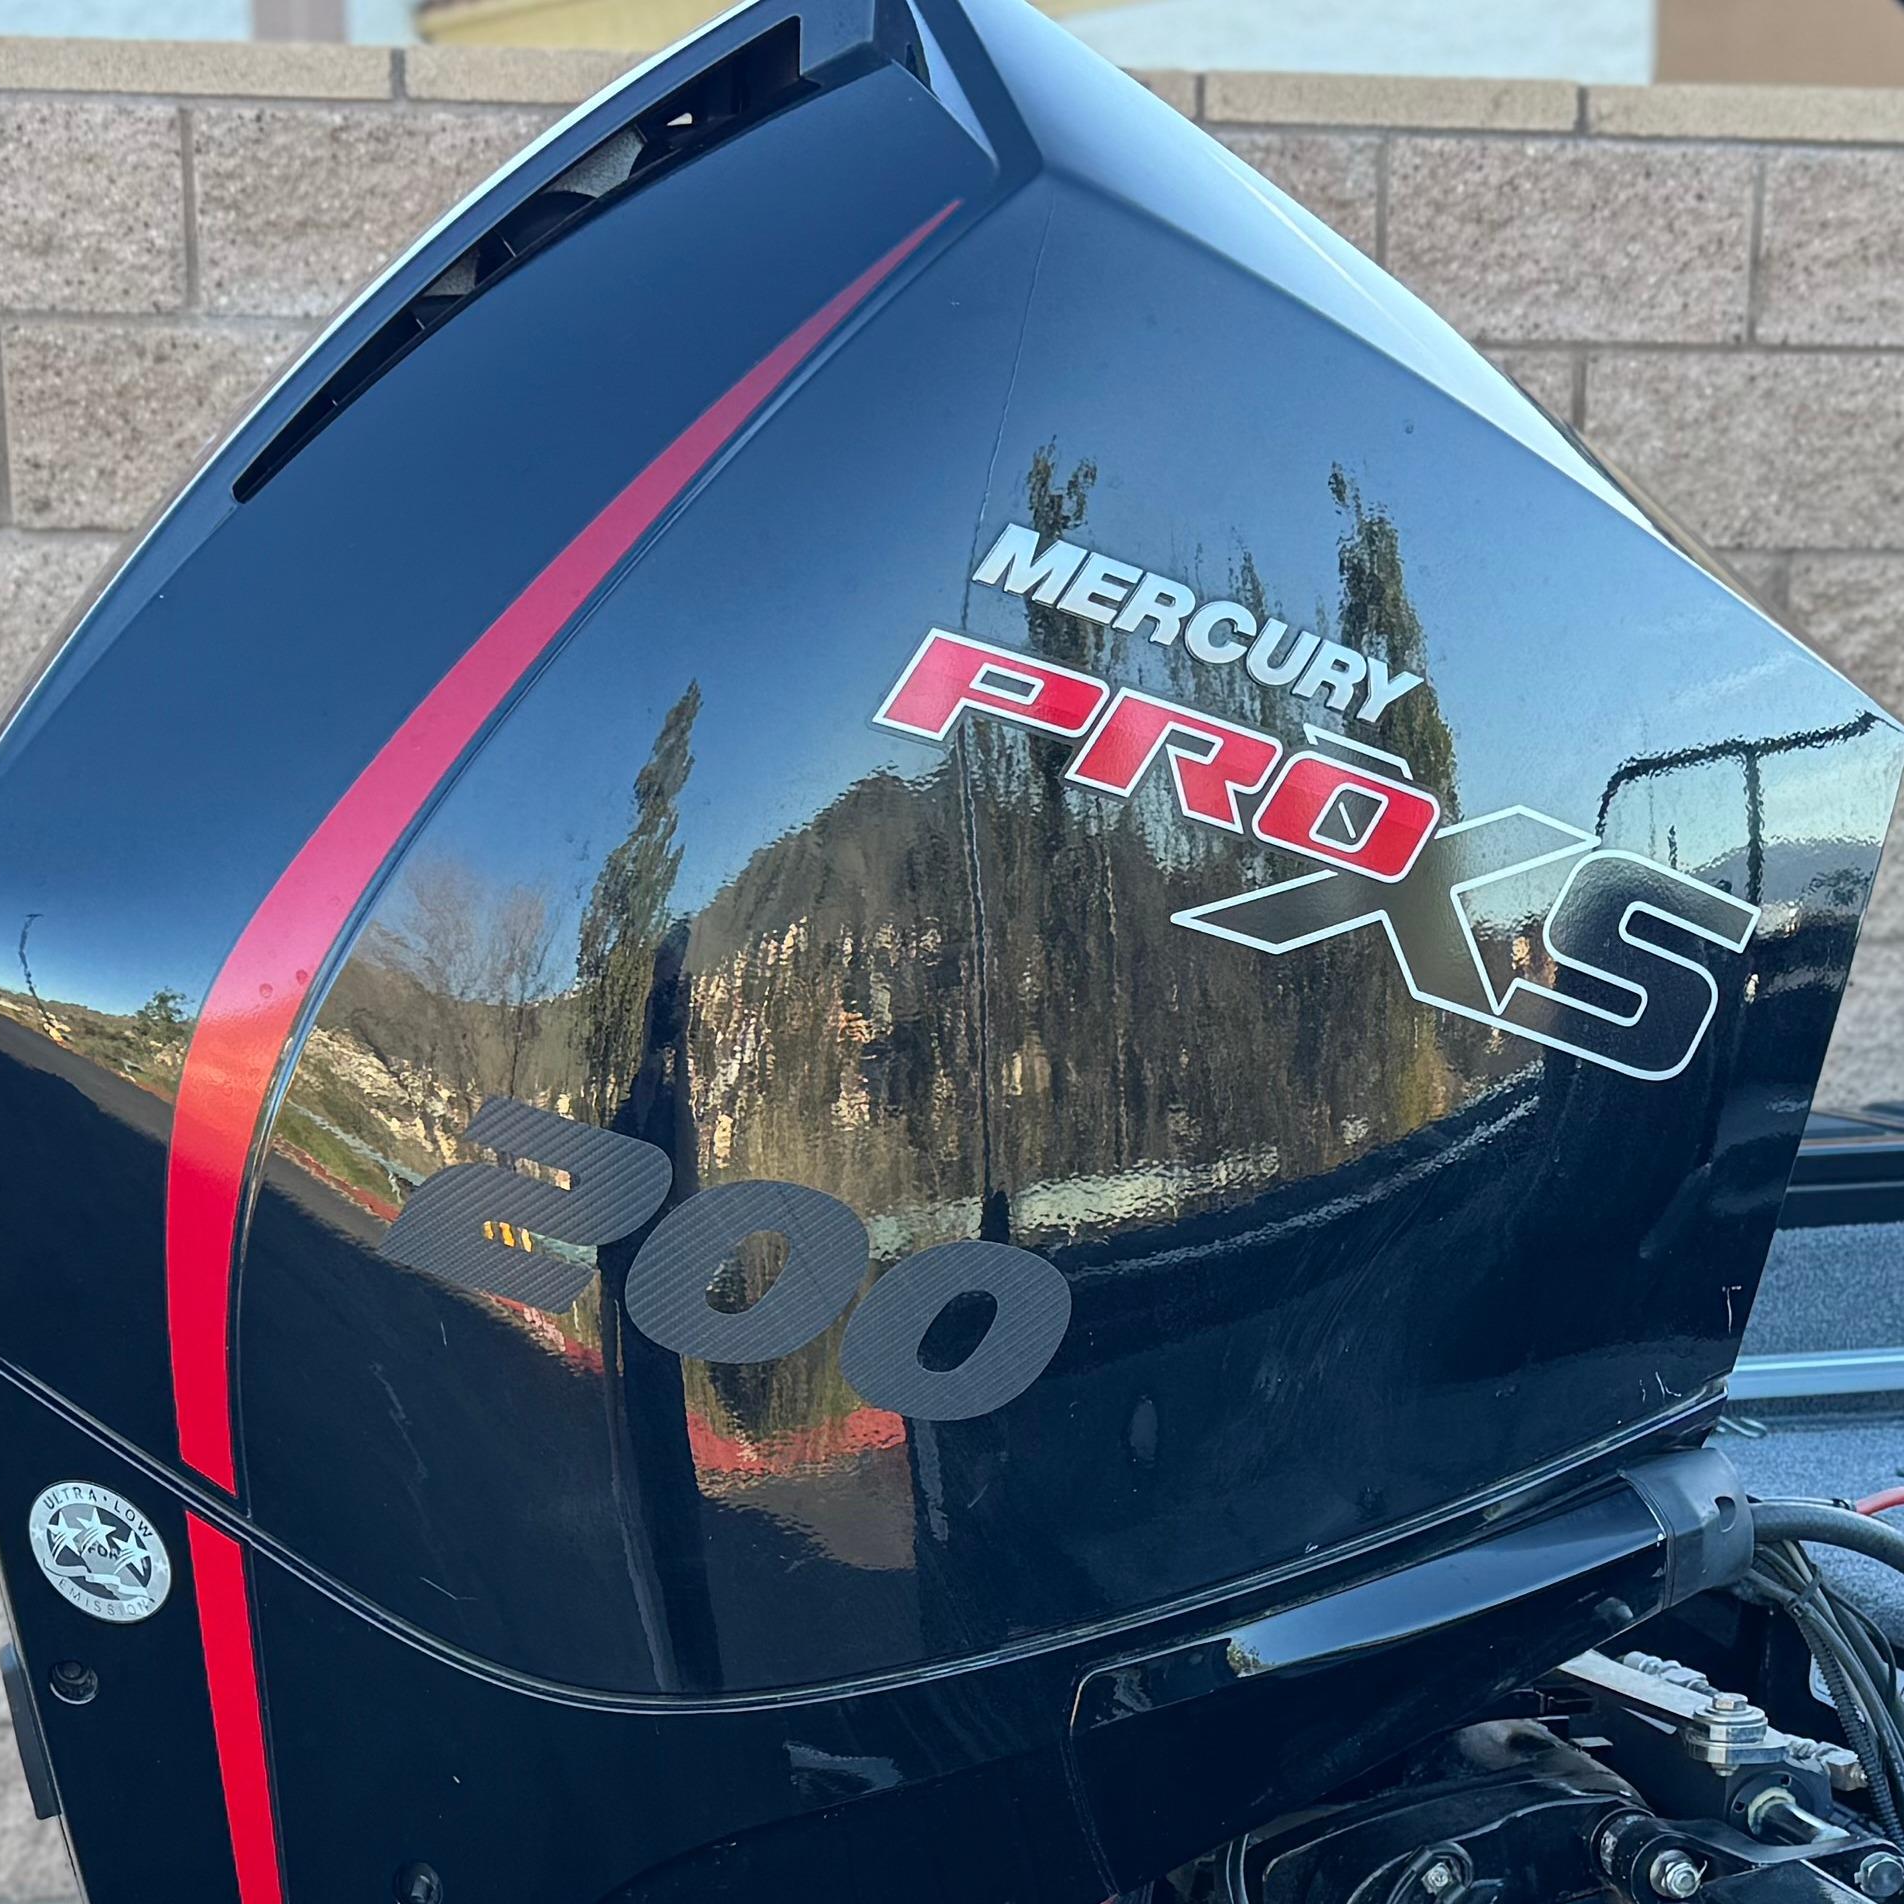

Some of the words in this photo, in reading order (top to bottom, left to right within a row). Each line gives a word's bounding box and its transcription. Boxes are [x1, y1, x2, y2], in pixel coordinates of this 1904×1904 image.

[971, 522, 1425, 723] MERCURY
[872, 626, 1440, 883] PRO
[1169, 723, 1763, 1082] XS
[379, 1095, 1072, 1421] 200
[43, 1487, 97, 1510] ULTRA
[114, 1500, 153, 1538] LOW
[58, 1578, 149, 1617] EMISSION
